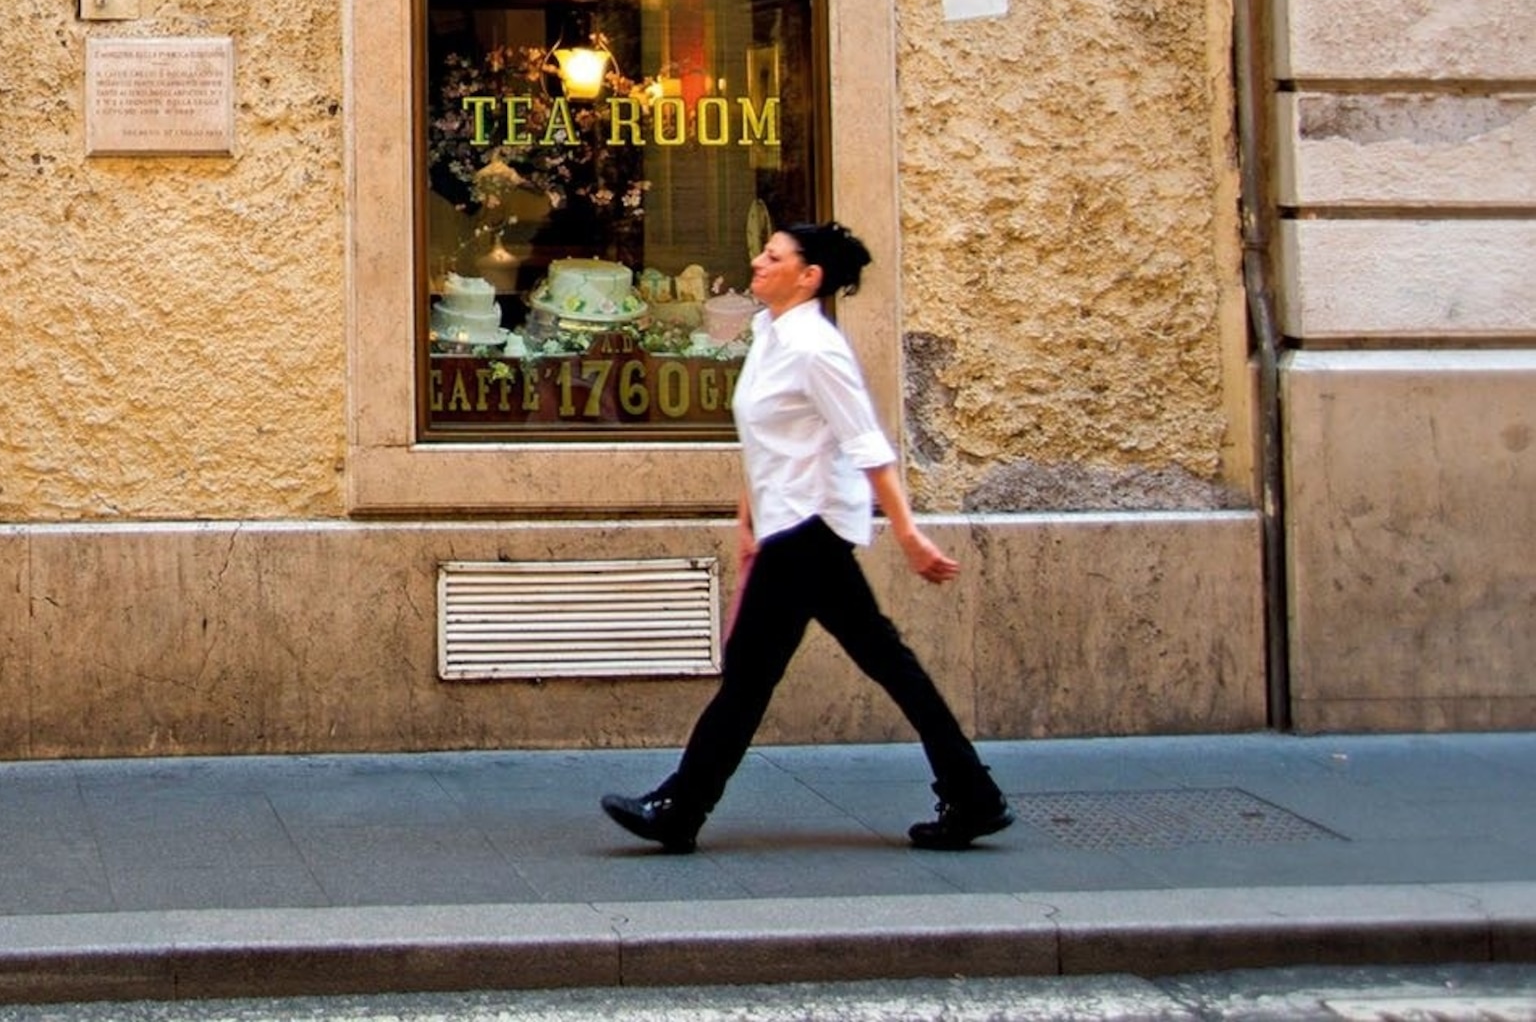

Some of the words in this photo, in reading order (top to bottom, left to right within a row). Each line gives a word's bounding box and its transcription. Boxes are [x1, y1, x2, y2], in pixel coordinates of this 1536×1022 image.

[463, 96, 580, 146] TEA
[605, 97, 782, 146] ROOM
[557, 360, 691, 419] 1760
